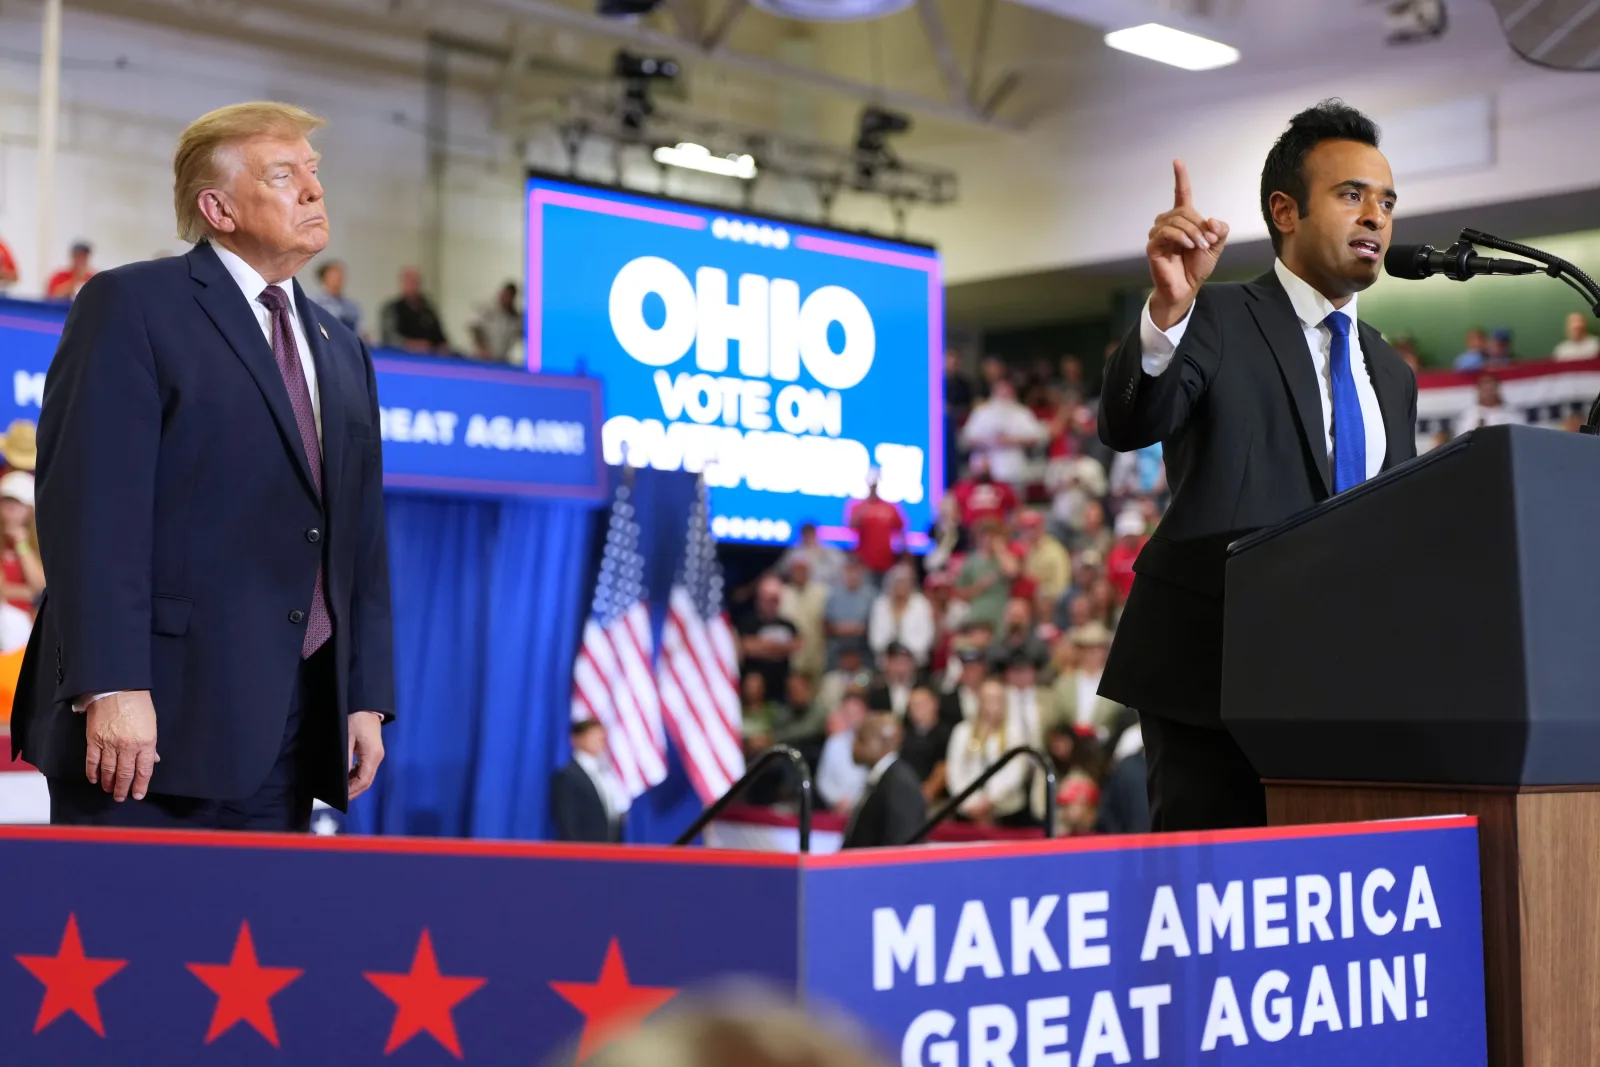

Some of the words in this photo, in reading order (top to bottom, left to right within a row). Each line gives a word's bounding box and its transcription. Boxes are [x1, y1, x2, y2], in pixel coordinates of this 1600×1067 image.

[608, 255, 876, 390] OHIO
[653, 369, 773, 431] VOTE
[775, 384, 842, 438] ON
[872, 890, 1111, 991] MAKE
[1140, 865, 1442, 962] AMERICA
[901, 983, 1172, 1067] GREAT
[1200, 952, 1428, 1052] AGAIN!
